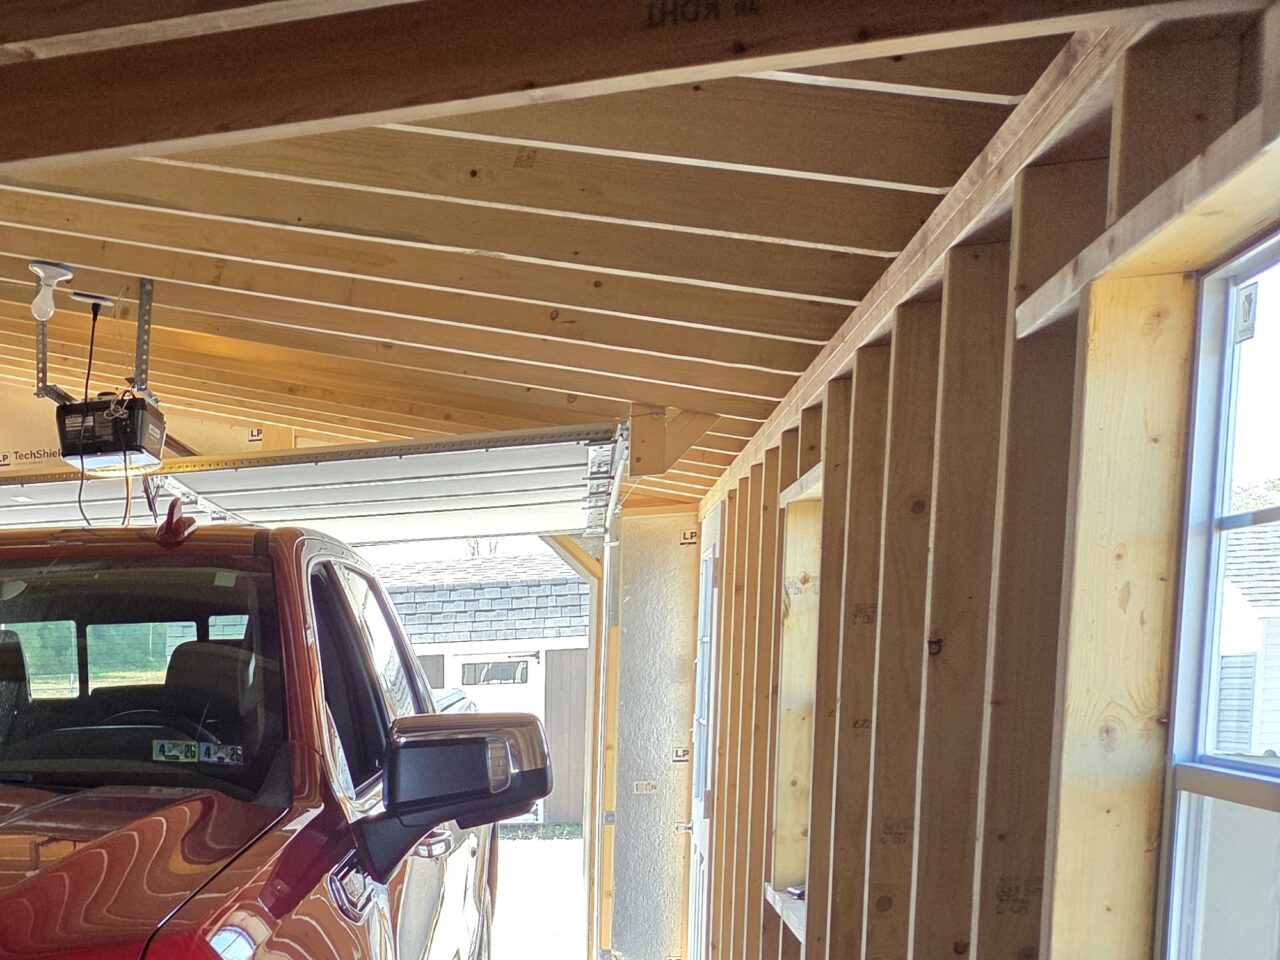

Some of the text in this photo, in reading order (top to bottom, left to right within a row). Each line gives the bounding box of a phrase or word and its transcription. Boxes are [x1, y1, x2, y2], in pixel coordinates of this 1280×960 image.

[251, 429, 262, 437] LP
[13, 449, 60, 461] TechShiel
[683, 532, 697, 540] LP
[675, 750, 689, 758] LP
